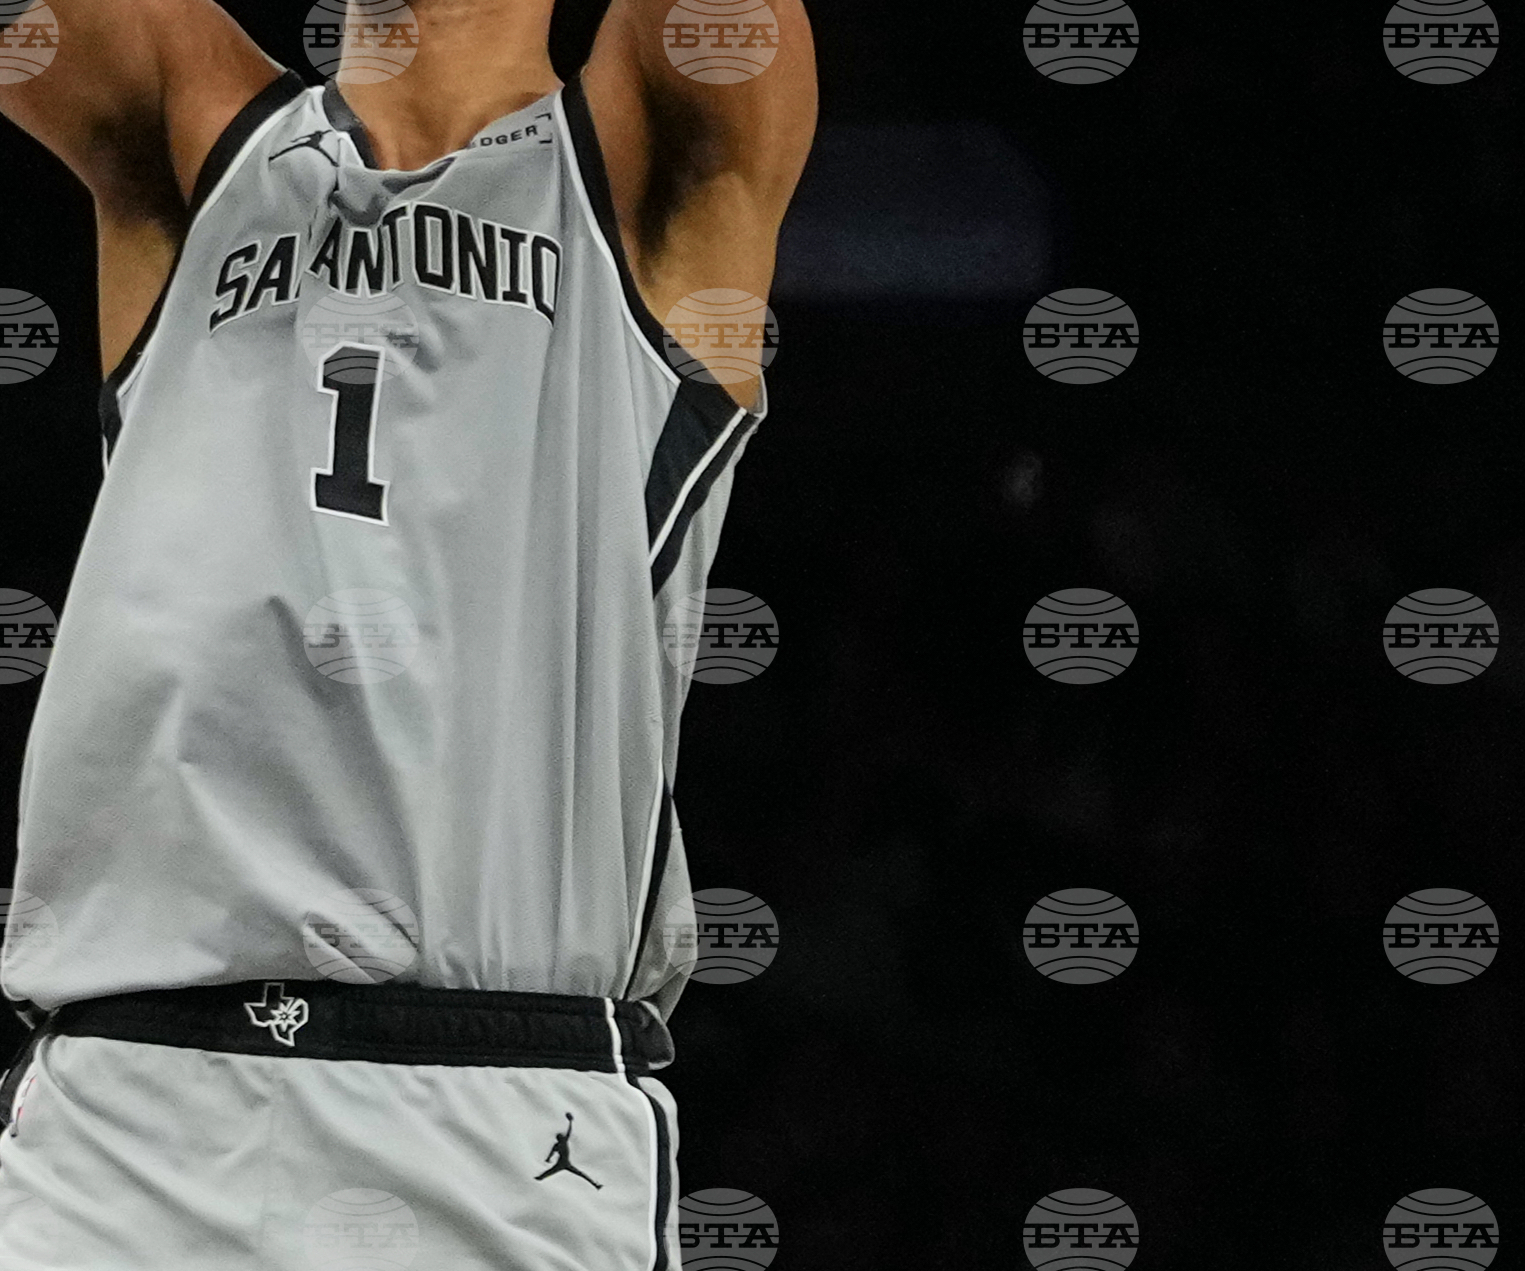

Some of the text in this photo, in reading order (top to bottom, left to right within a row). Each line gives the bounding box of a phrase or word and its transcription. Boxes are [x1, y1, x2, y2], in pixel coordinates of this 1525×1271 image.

[479, 124, 538, 147] DGER
[210, 201, 563, 336] SA ANTONIO
[310, 340, 390, 526] 1
